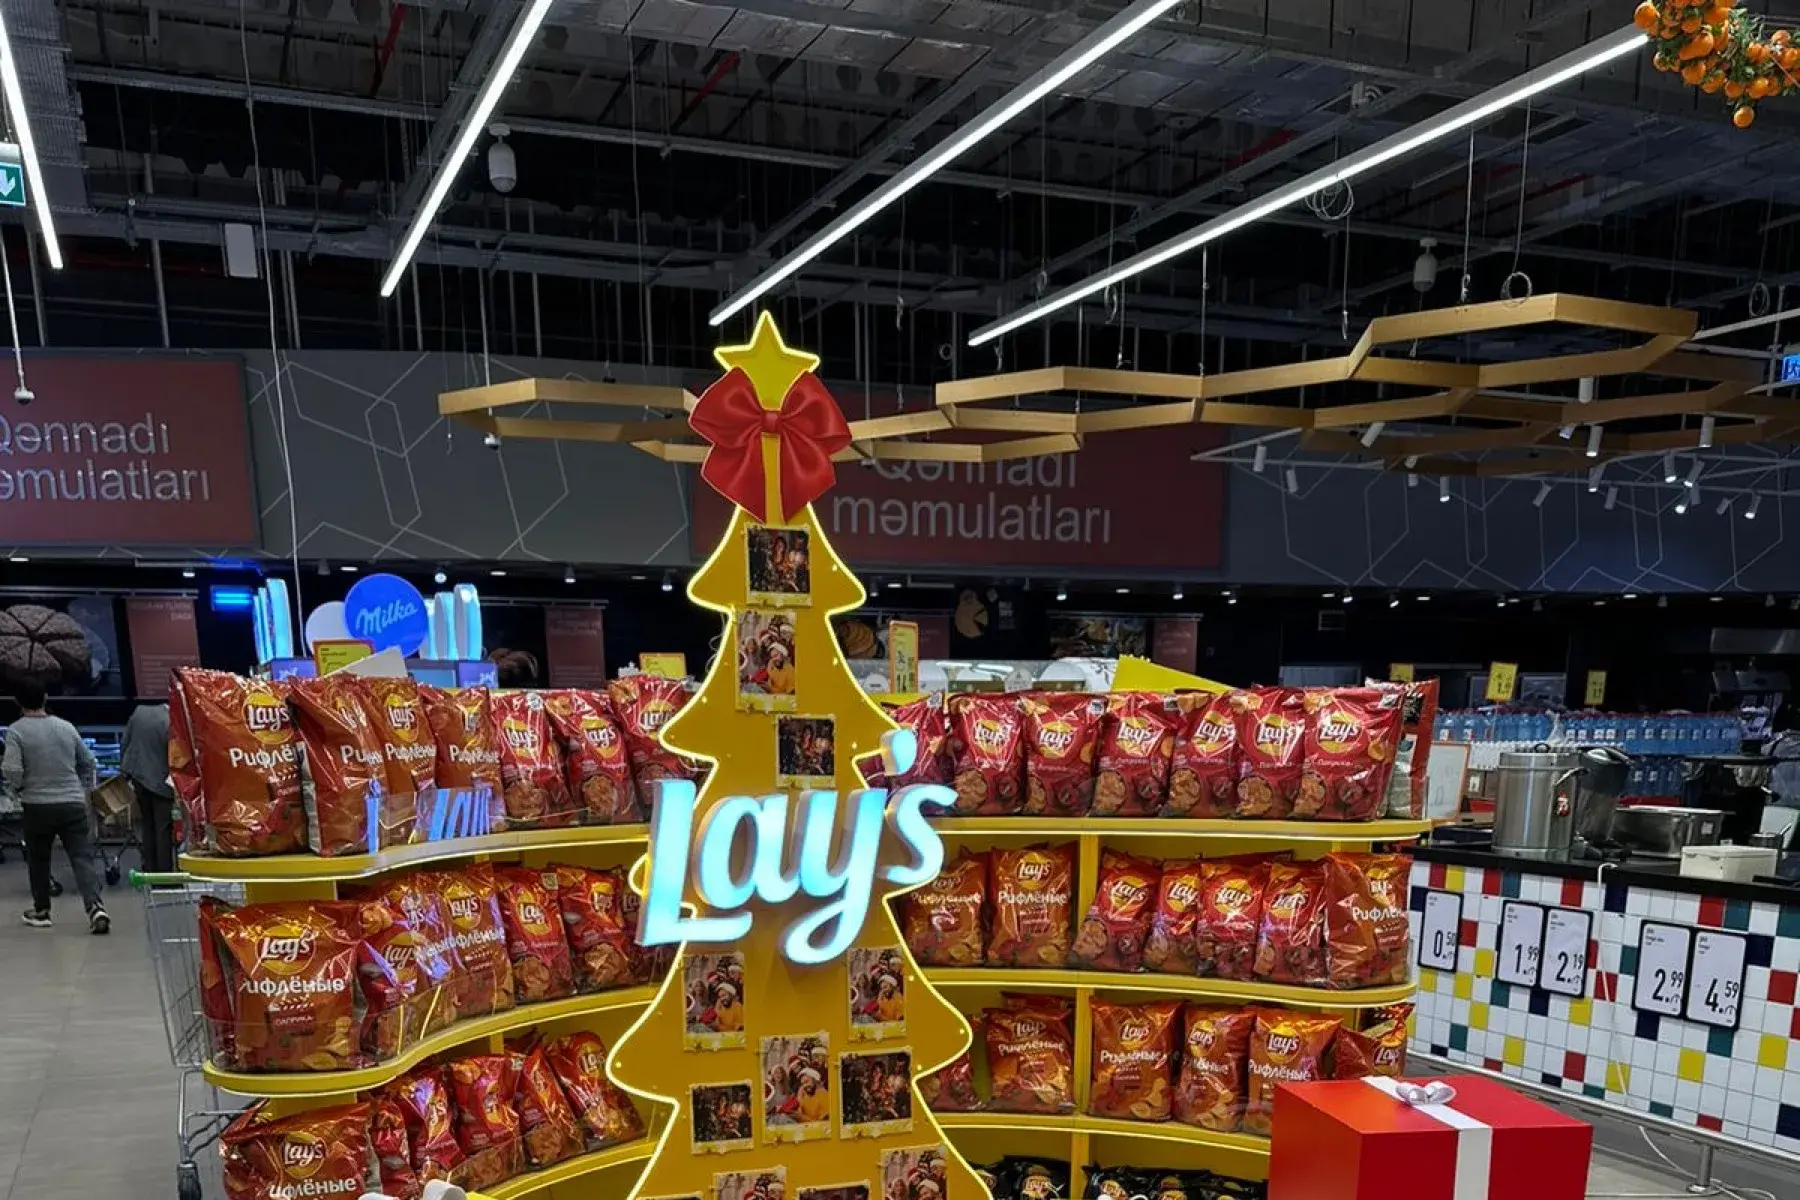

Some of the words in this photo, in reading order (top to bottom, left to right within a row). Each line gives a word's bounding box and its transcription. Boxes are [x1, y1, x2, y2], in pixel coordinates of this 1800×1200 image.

[0, 412, 169, 455] ənnadı
[833, 493, 1111, 544] məmulatları
[355, 599, 419, 635] Milka
[636, 728, 959, 964] Lay's
[1168, 880, 1199, 906] Lay
